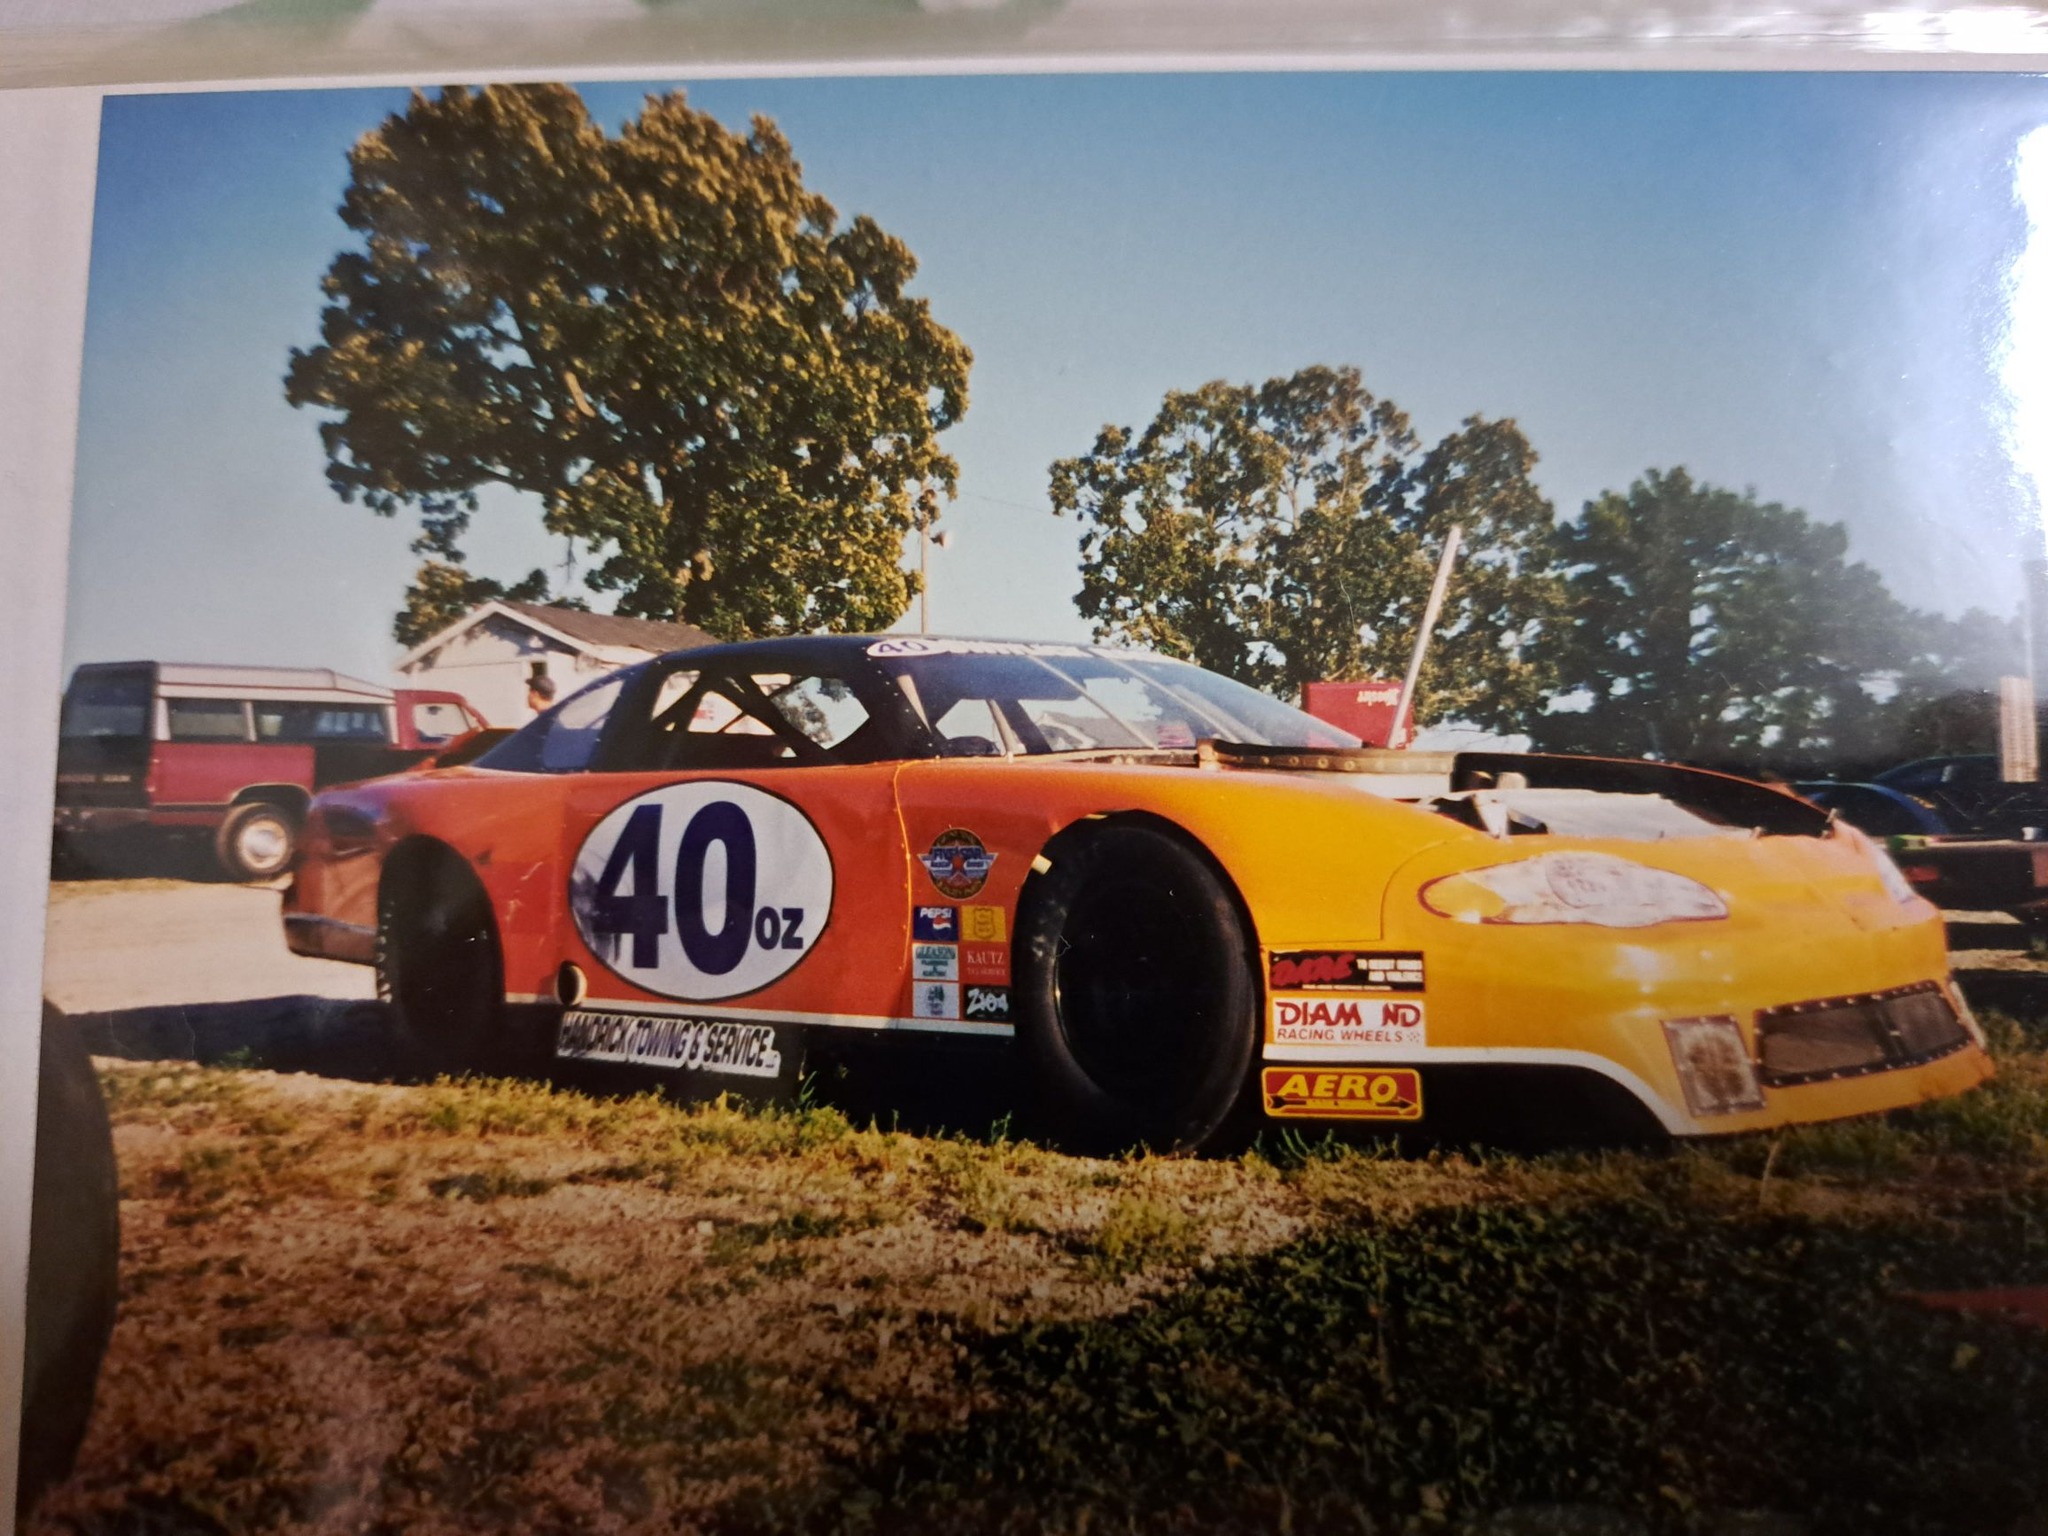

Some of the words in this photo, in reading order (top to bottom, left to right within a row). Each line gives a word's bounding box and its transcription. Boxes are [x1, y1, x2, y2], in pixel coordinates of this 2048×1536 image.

[878, 640, 929, 653] 40
[593, 801, 756, 975] 40
[920, 907, 952, 918] PEPSI
[627, 1019, 692, 1059] TOWING
[703, 1024, 772, 1069] SERVICE
[1277, 1028, 1335, 1040] RACING
[1341, 1030, 1403, 1042] WHEELS
[1277, 1074, 1398, 1103] AERO
